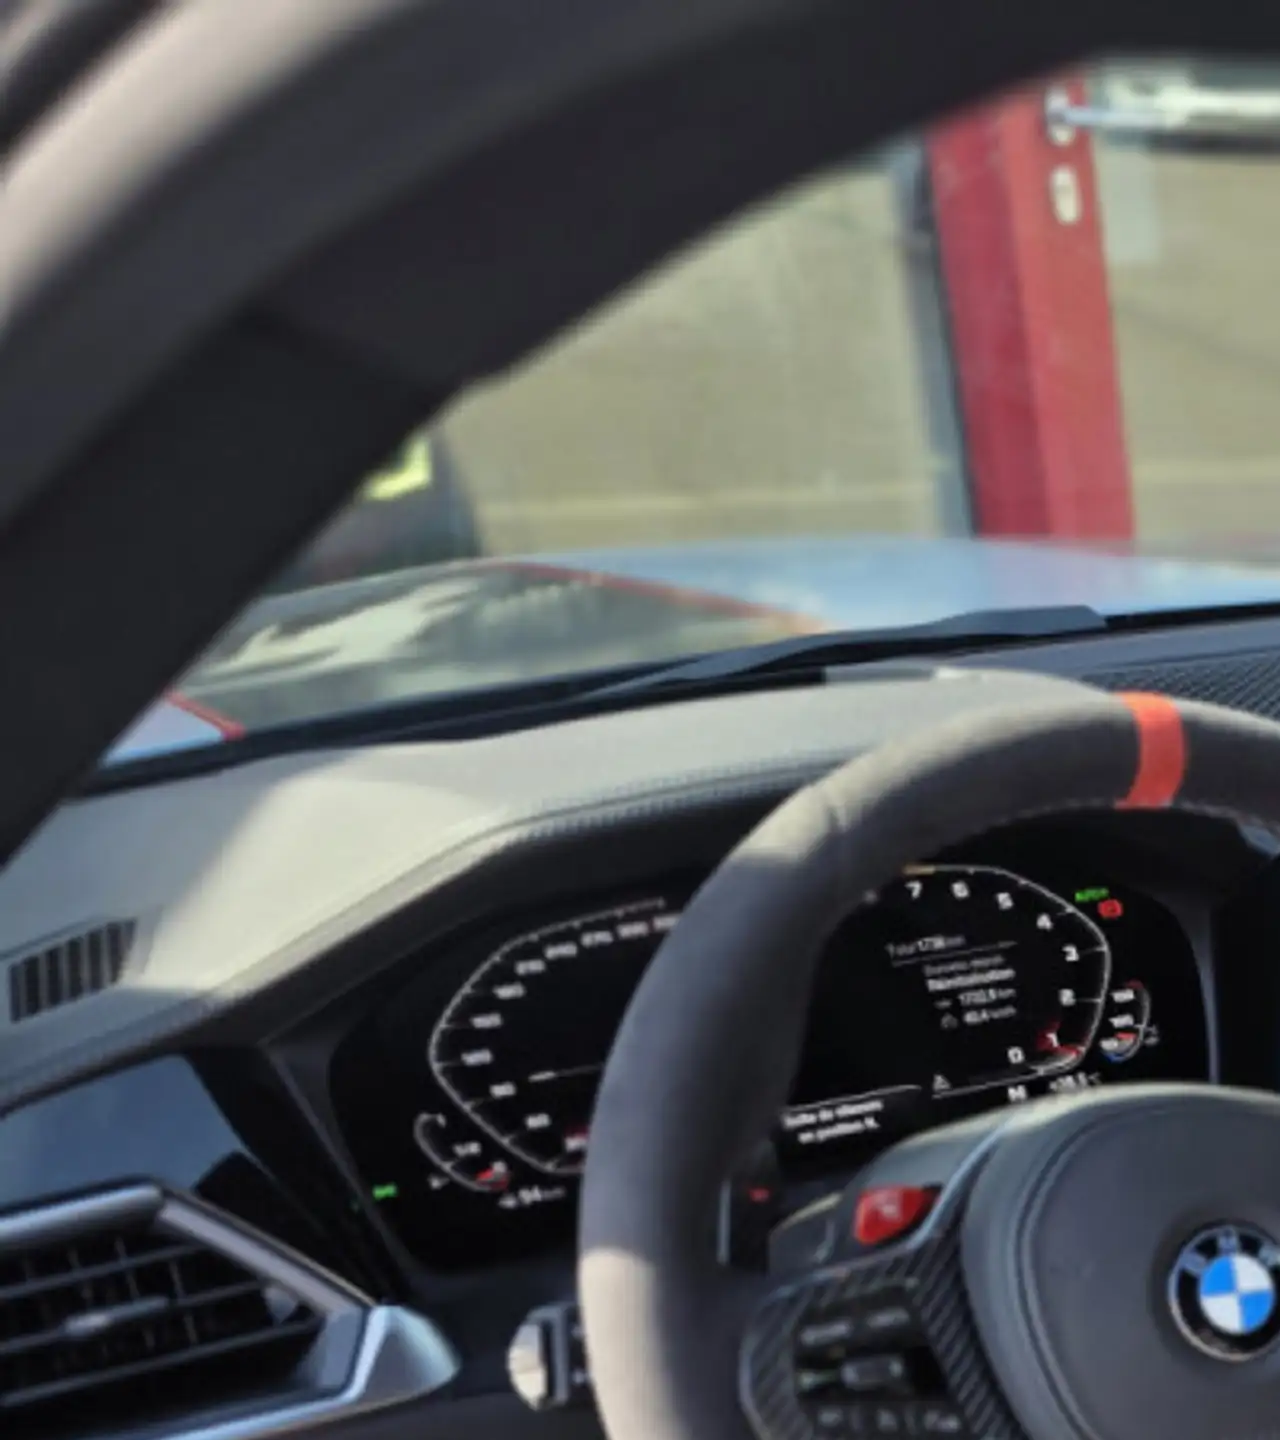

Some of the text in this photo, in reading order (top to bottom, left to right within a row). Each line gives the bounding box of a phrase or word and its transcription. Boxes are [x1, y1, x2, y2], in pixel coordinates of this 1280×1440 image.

[906, 880, 922, 899] 7
[951, 880, 970, 899] 6
[1036, 912, 1054, 931] 4
[1062, 944, 1080, 962] 3
[1058, 987, 1076, 1007] 2
